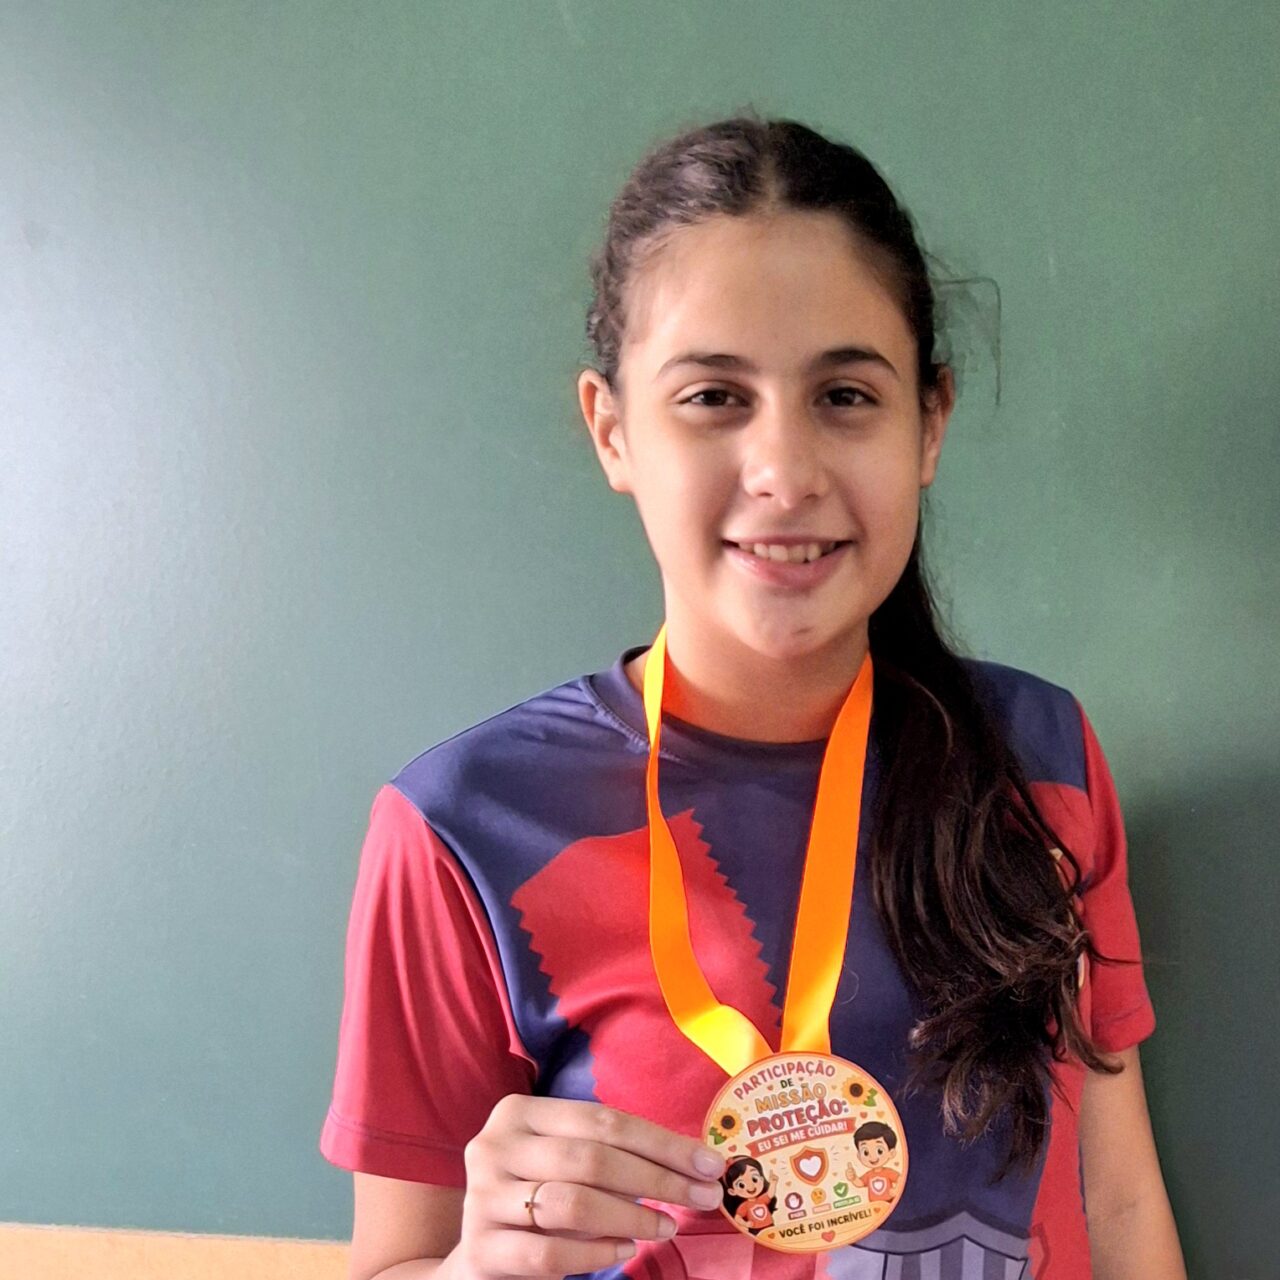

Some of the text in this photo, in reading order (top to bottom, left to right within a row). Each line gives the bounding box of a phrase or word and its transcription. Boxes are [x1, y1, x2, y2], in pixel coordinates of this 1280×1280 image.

[734, 1060, 836, 1100] PARTICIPAÇÃO
[780, 1078, 794, 1088] DE
[755, 1083, 827, 1114] MISSÃO
[747, 1098, 849, 1137] PROTEÇÃO:
[758, 1121, 848, 1152] EU SEI ME CUIDAR!
[779, 1209, 872, 1239] VOCÊ FOI INCRÍVEL!
